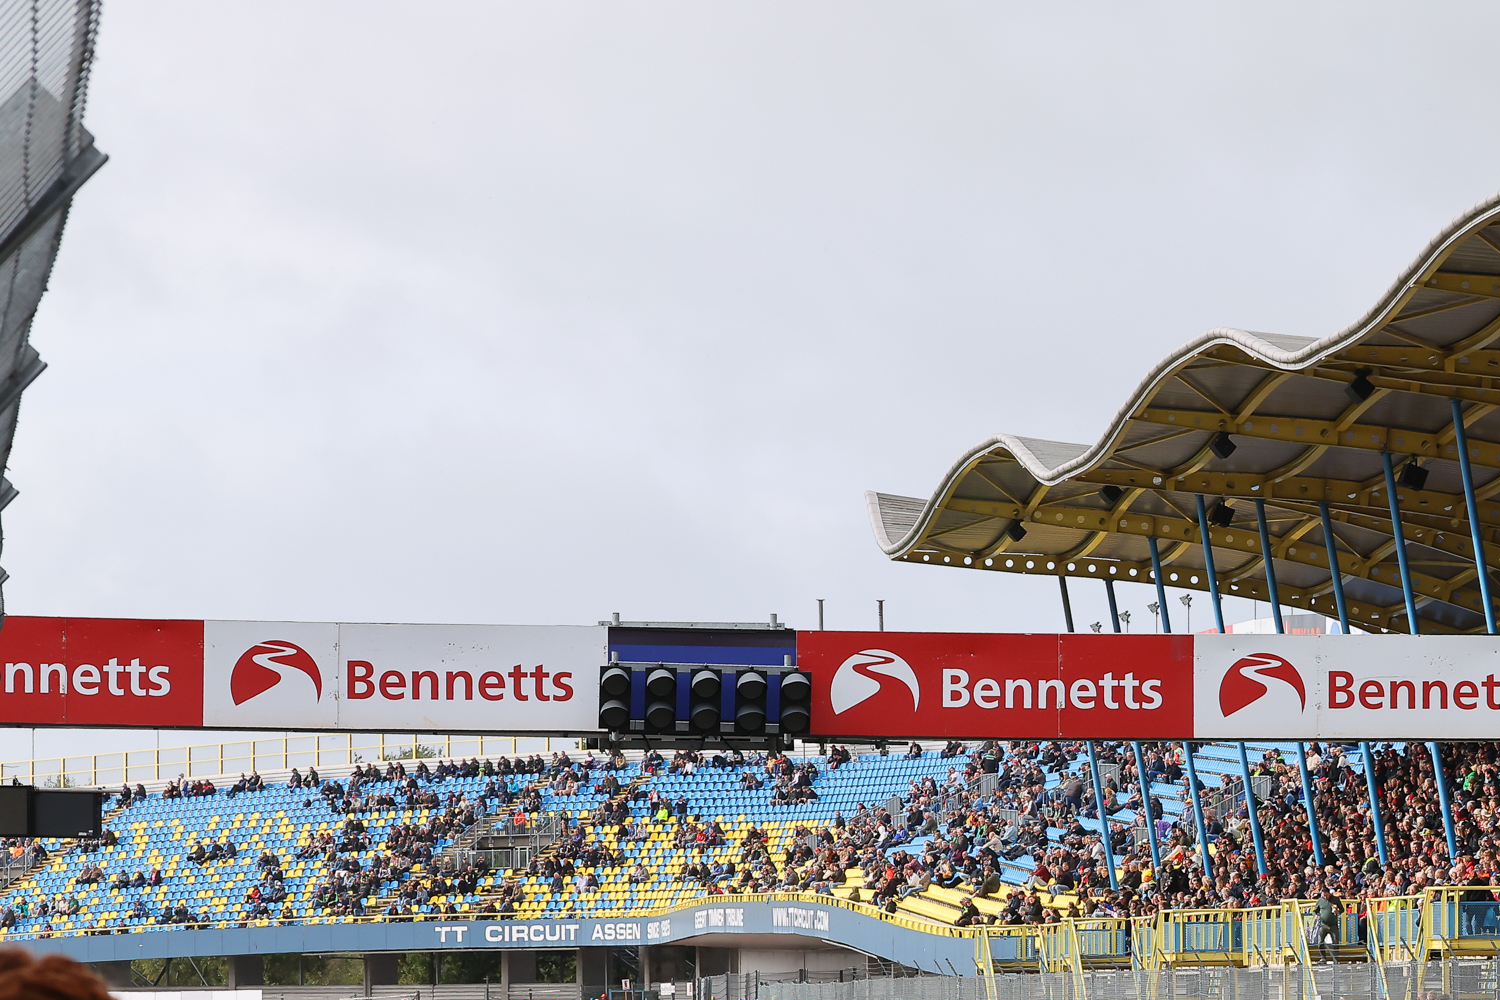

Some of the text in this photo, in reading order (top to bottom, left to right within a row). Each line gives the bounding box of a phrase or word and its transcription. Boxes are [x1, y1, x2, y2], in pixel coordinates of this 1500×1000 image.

[347, 659, 574, 702] Bennetts
[942, 668, 1163, 711] Bennetts
[434, 926, 468, 943] TT
[484, 924, 580, 942] CIRCUIT
[591, 923, 641, 941] ASSEN
